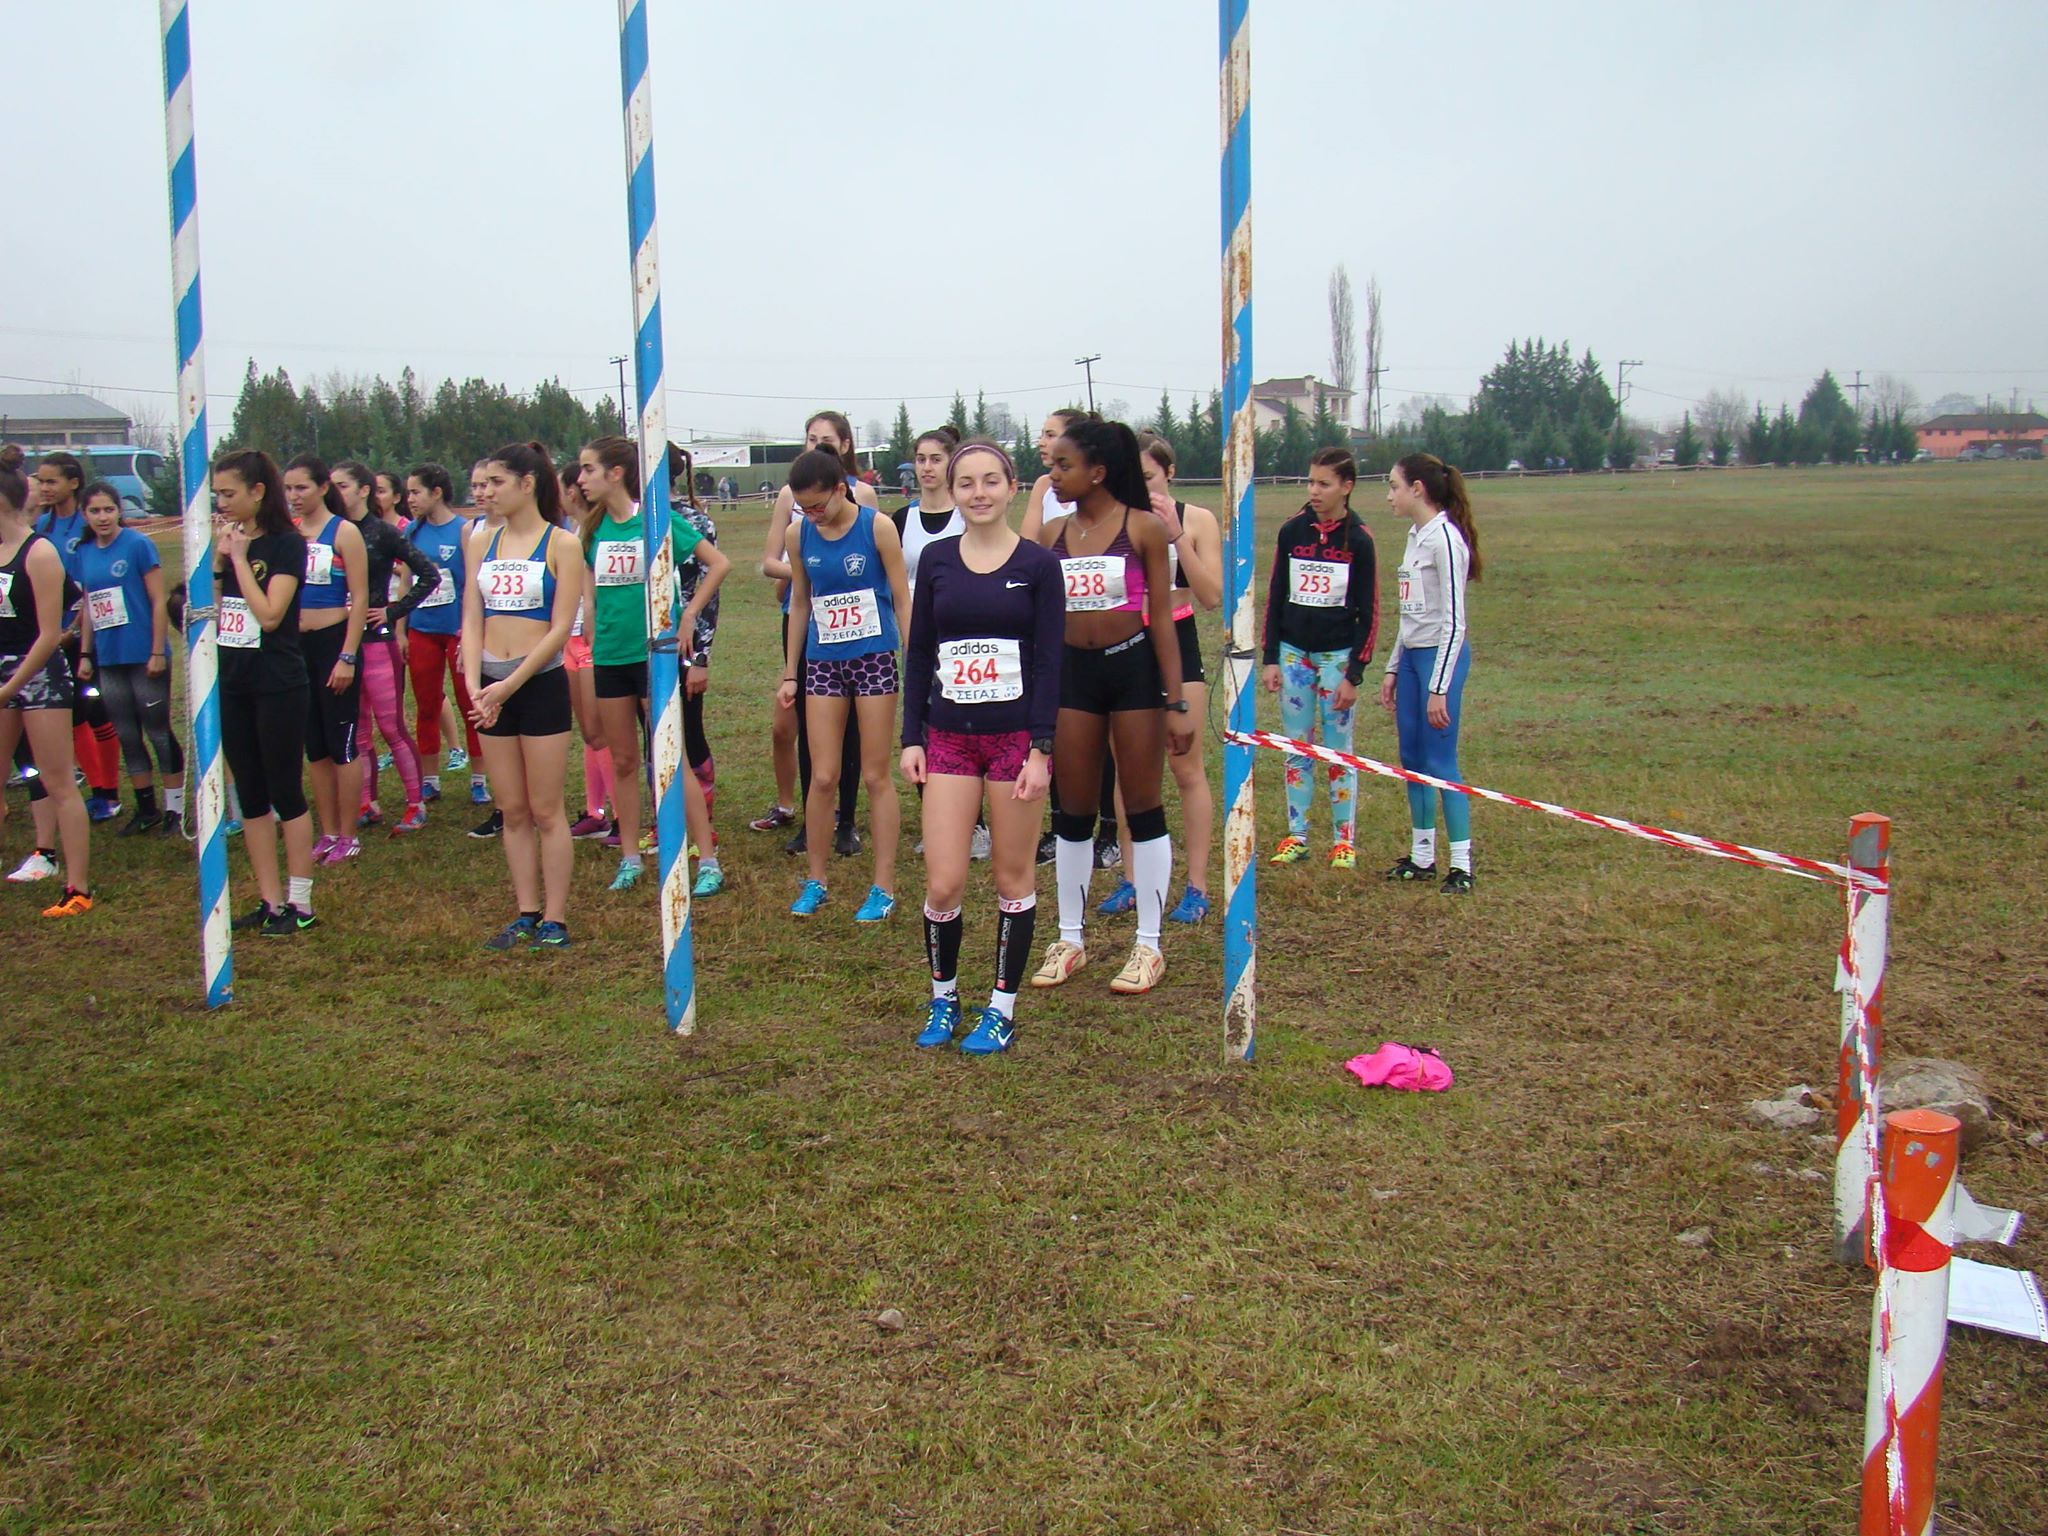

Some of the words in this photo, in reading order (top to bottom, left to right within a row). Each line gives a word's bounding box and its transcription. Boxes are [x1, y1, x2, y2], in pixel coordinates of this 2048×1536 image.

[607, 544, 637, 553] adidas
[492, 561, 529, 573] adidas
[608, 555, 636, 574] 217
[1064, 559, 1107, 571] adidas
[1299, 562, 1335, 574] adidas
[490, 574, 525, 596] 233
[1066, 573, 1105, 597] 238
[1299, 574, 1331, 594] 253
[92, 600, 113, 619] 304
[824, 595, 861, 608] adidas
[220, 612, 244, 633] 228
[827, 606, 862, 630] 275
[832, 628, 865, 640] ΣΕΓΑΣ
[950, 642, 999, 656] adidas
[952, 657, 999, 685] 264
[956, 688, 1000, 700] ΣΕΓΑΣ
